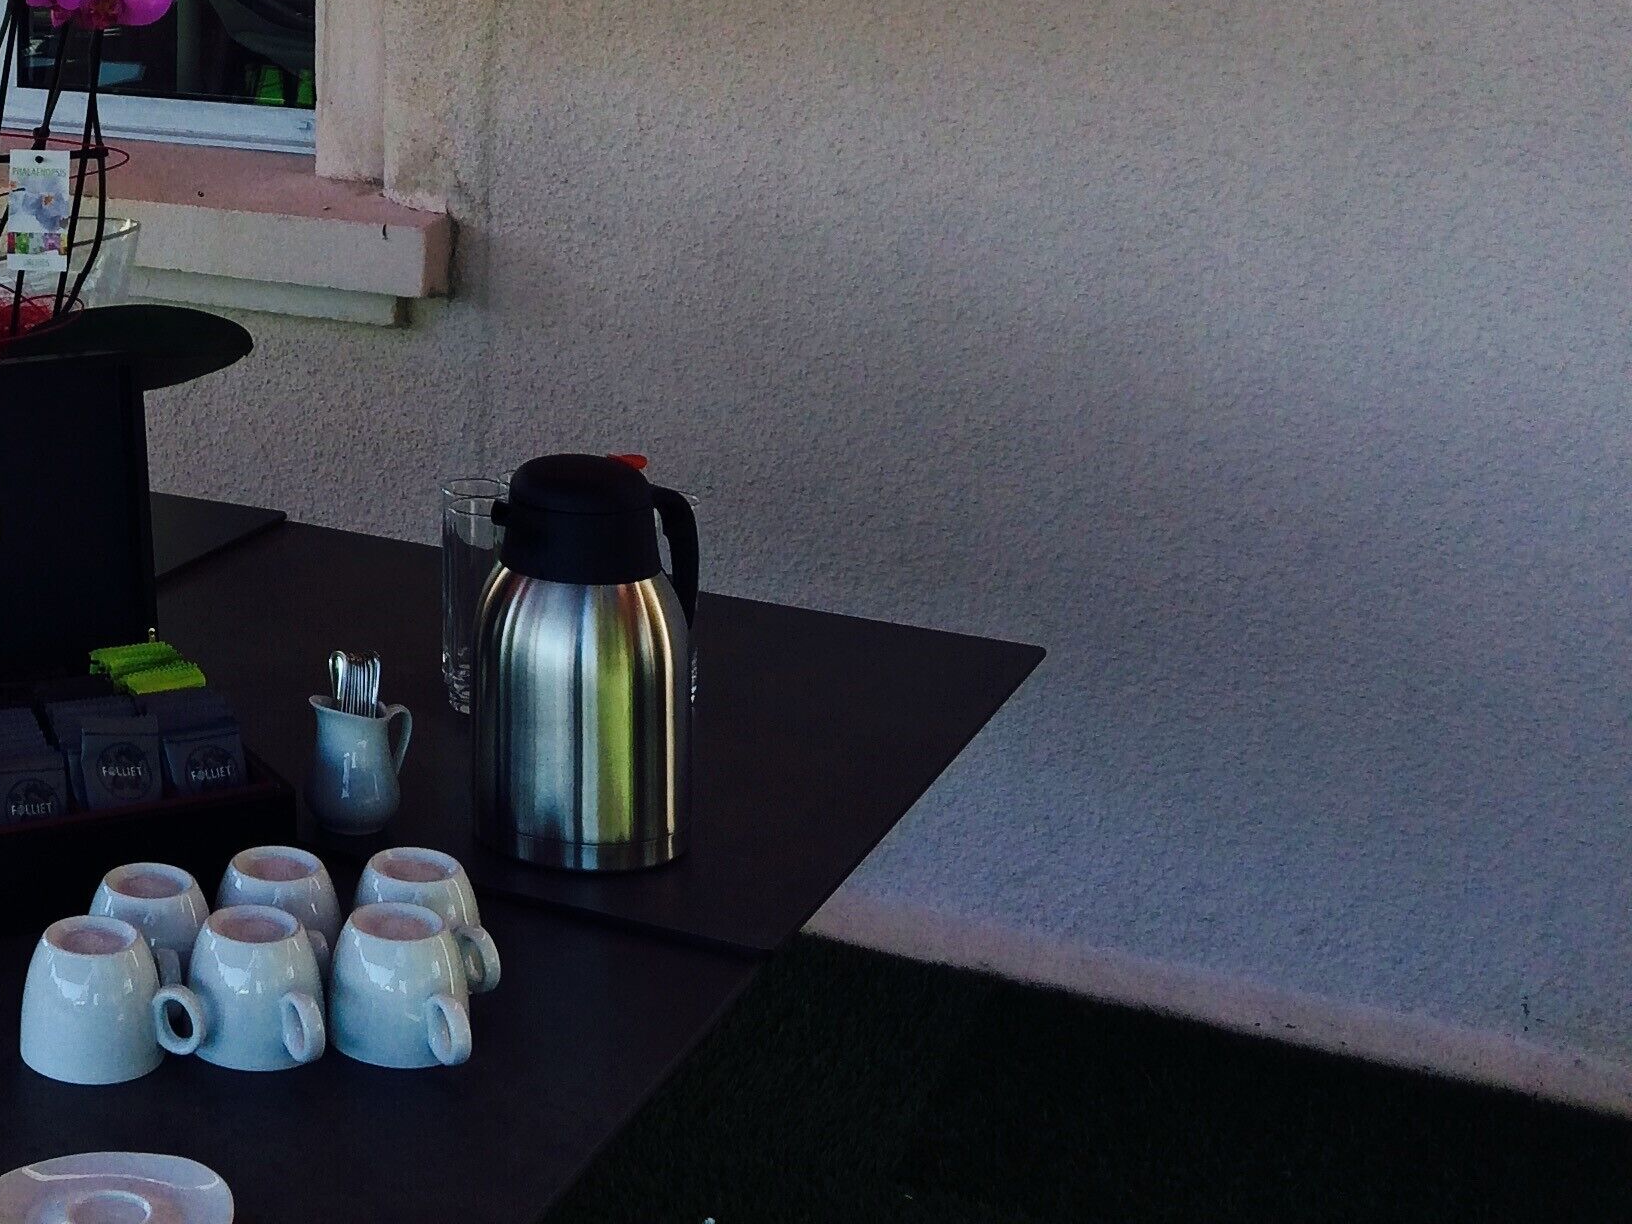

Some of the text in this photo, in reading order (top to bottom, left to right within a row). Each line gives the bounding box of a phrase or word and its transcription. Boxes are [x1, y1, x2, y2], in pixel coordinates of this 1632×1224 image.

[102, 765, 143, 777] FOLLIET
[191, 765, 232, 781] FOLLIET
[11, 801, 53, 816] FOLLIET
